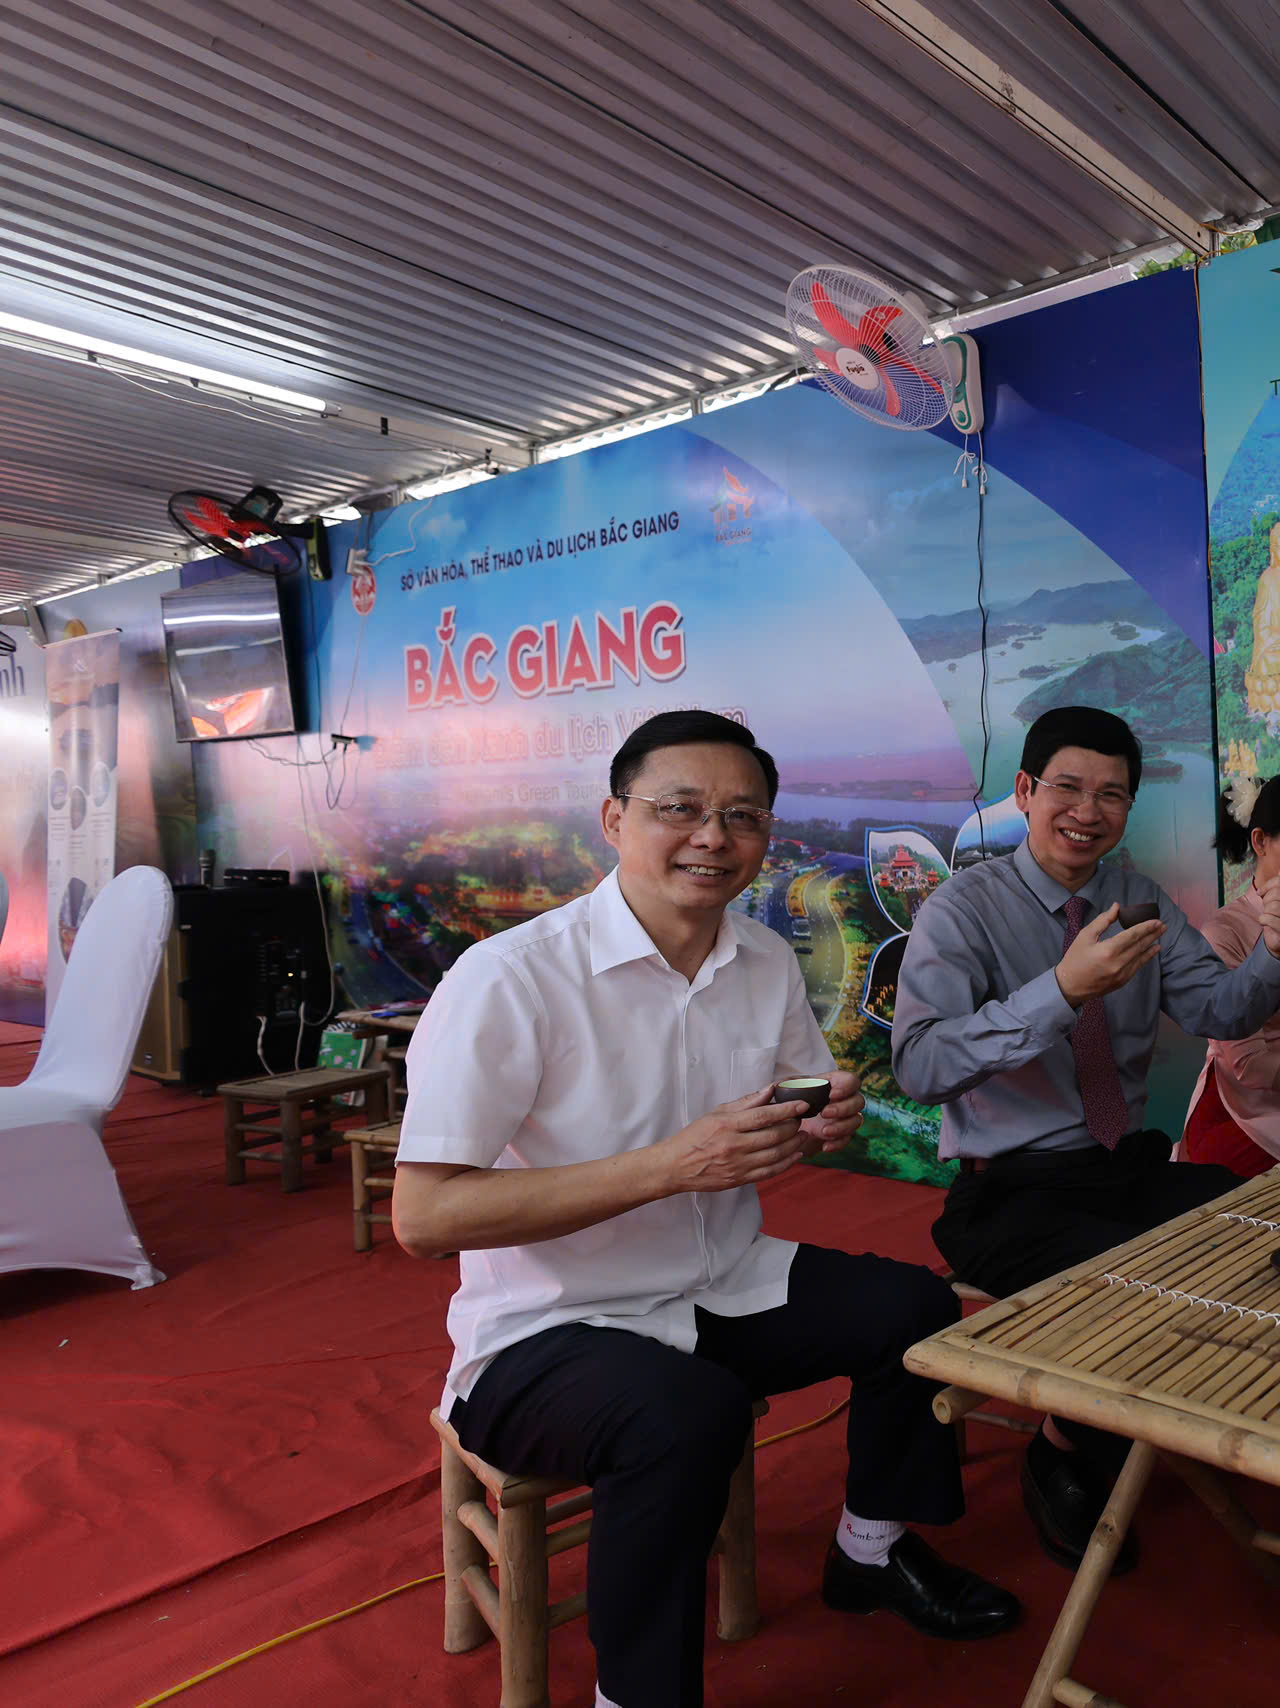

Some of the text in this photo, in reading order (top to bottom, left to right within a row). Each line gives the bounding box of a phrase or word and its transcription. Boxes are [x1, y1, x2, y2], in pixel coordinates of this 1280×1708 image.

[416, 567, 439, 588] VĂN
[470, 546, 490, 576] THỂ
[493, 549, 524, 571] THAO
[526, 539, 544, 563] VÀ
[547, 540, 563, 559] DU
[568, 530, 597, 559] LỊCH
[600, 516, 628, 546] BẮC
[632, 511, 680, 539] GIANG
[405, 600, 687, 712] BẮC GIANG
[535, 720, 565, 758] du
[568, 712, 613, 762] lịch
[518, 784, 560, 802] Green
